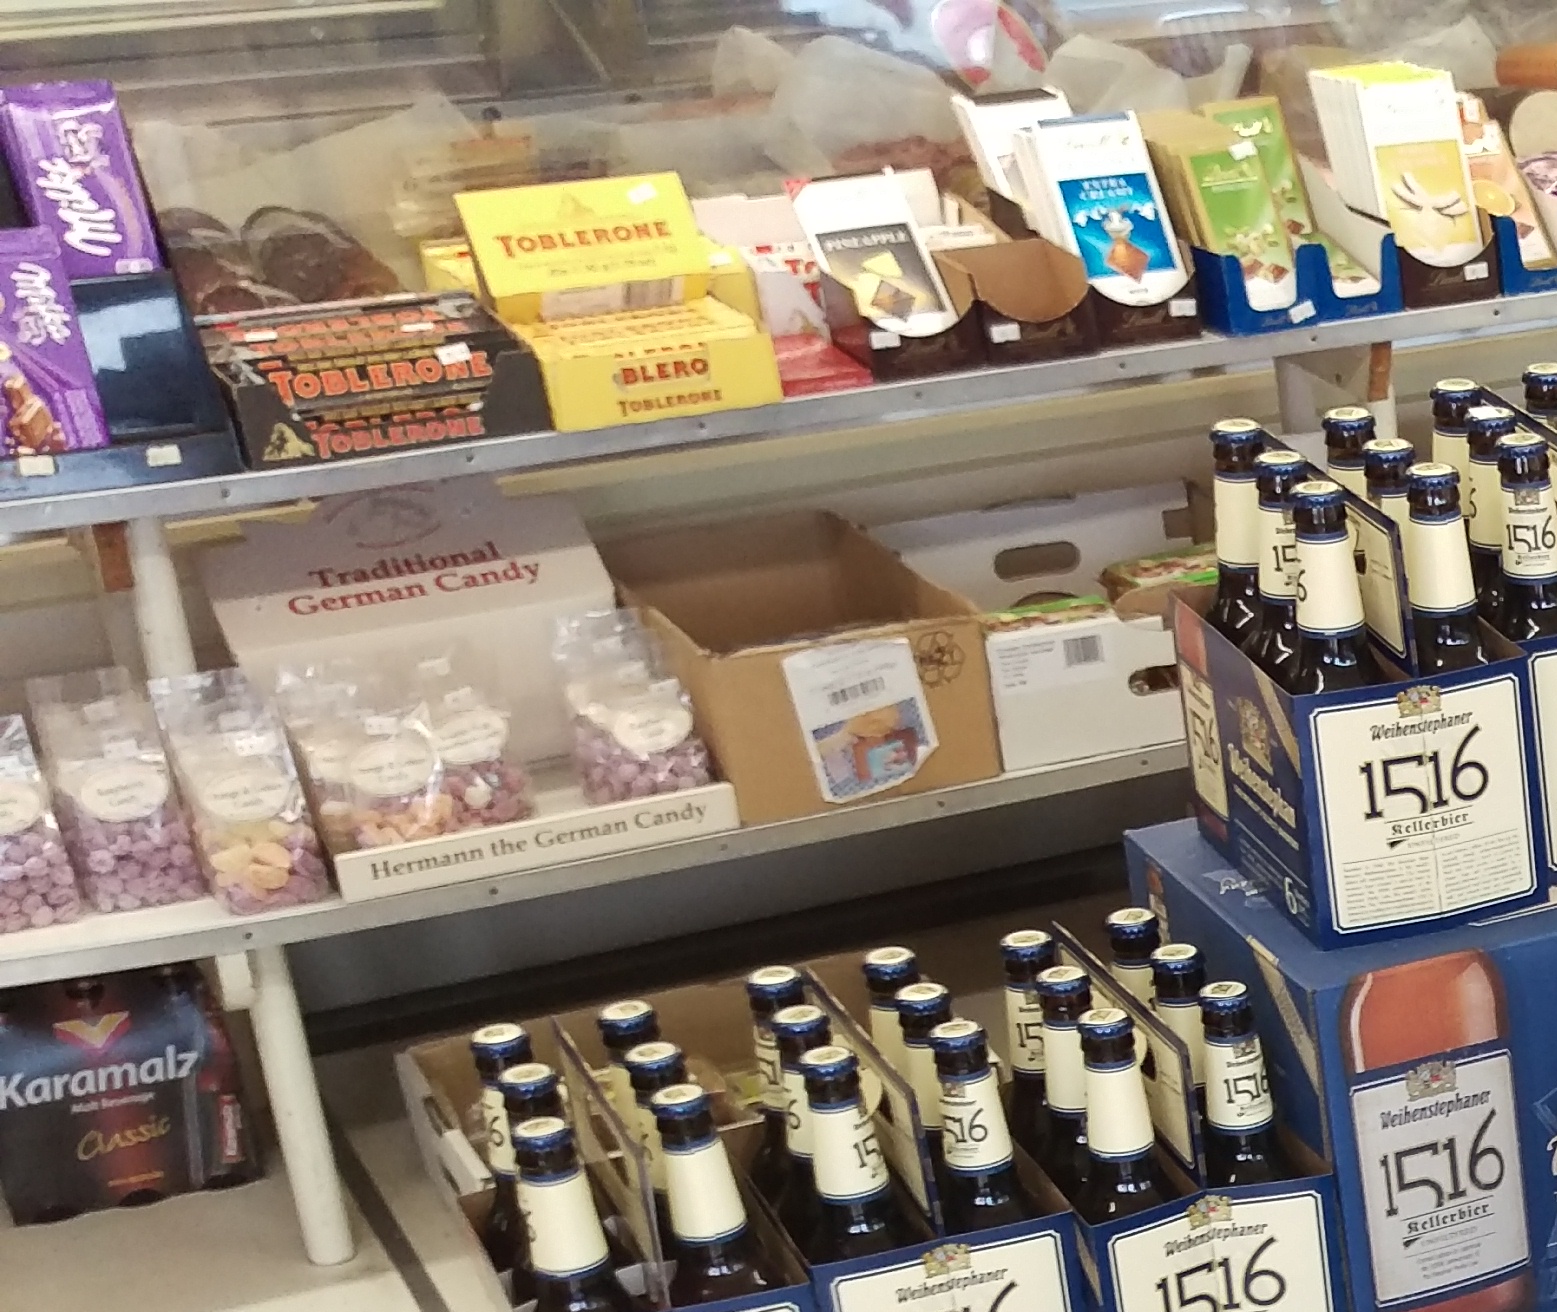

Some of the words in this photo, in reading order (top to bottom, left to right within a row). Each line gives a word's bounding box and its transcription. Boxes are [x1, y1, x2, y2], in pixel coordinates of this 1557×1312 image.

[496, 219, 671, 259] TOBLERONE
[268, 351, 493, 407] TOBLERONE
[616, 388, 723, 417] TOBLERONE
[311, 416, 485, 459] TOBLERONE
[1505, 516, 1557, 554] 1516
[308, 540, 501, 591] Traditional
[288, 580, 427, 617] German
[435, 560, 541, 595] Candy
[1369, 710, 1473, 741] Weihenstephaner
[1359, 724, 1490, 820] 1516
[370, 847, 482, 882] Hermann
[489, 838, 527, 859] the
[533, 821, 629, 852] German
[633, 803, 708, 830] Candy
[1390, 810, 1470, 838] Kellerbier
[0, 1044, 198, 1110] Karamalz
[1379, 1088, 1491, 1131] Weihenstephaner
[77, 1115, 171, 1161] Classic
[1378, 1107, 1505, 1218] 1516
[1164, 1221, 1269, 1258] Weihenstephaner
[1406, 1201, 1490, 1236] Kellerbier
[896, 1265, 1008, 1303] Weihenstephaner
